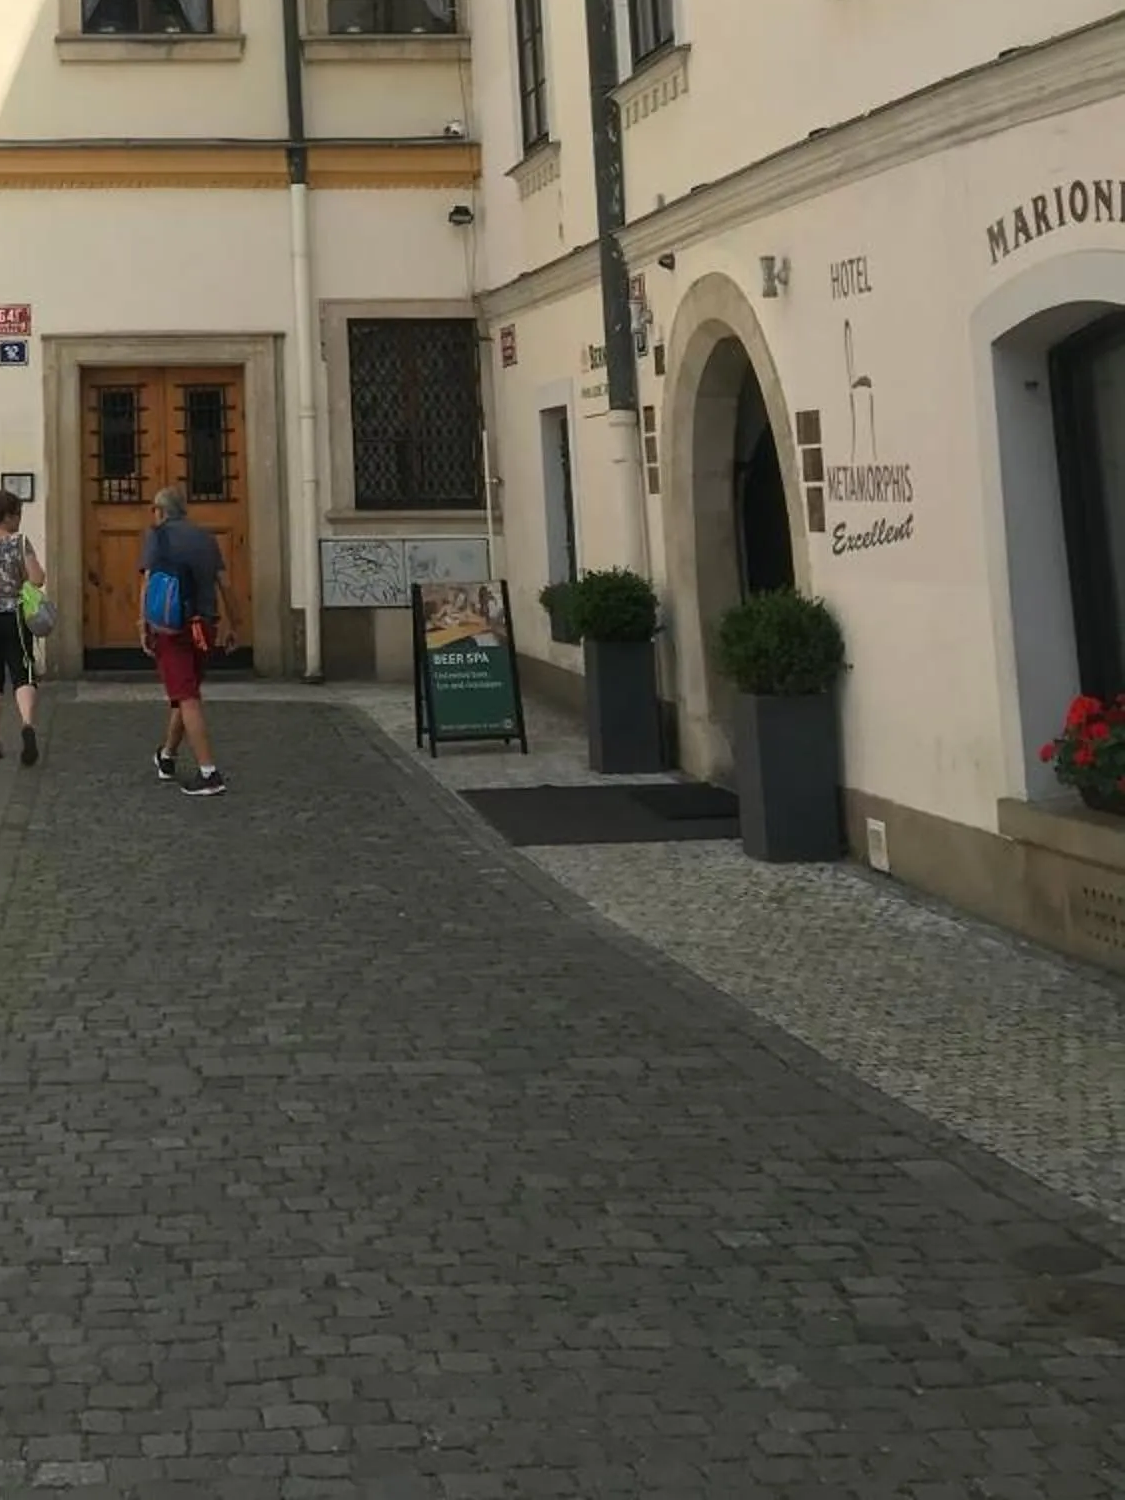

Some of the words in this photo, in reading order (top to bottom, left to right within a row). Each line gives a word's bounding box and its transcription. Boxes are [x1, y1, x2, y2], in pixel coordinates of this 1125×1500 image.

[830, 257, 872, 299] HOTEL
[826, 464, 913, 502] METAMORPHIS
[832, 513, 913, 555] Excellent
[433, 653, 463, 665] BEER
[466, 651, 490, 665] SPA
